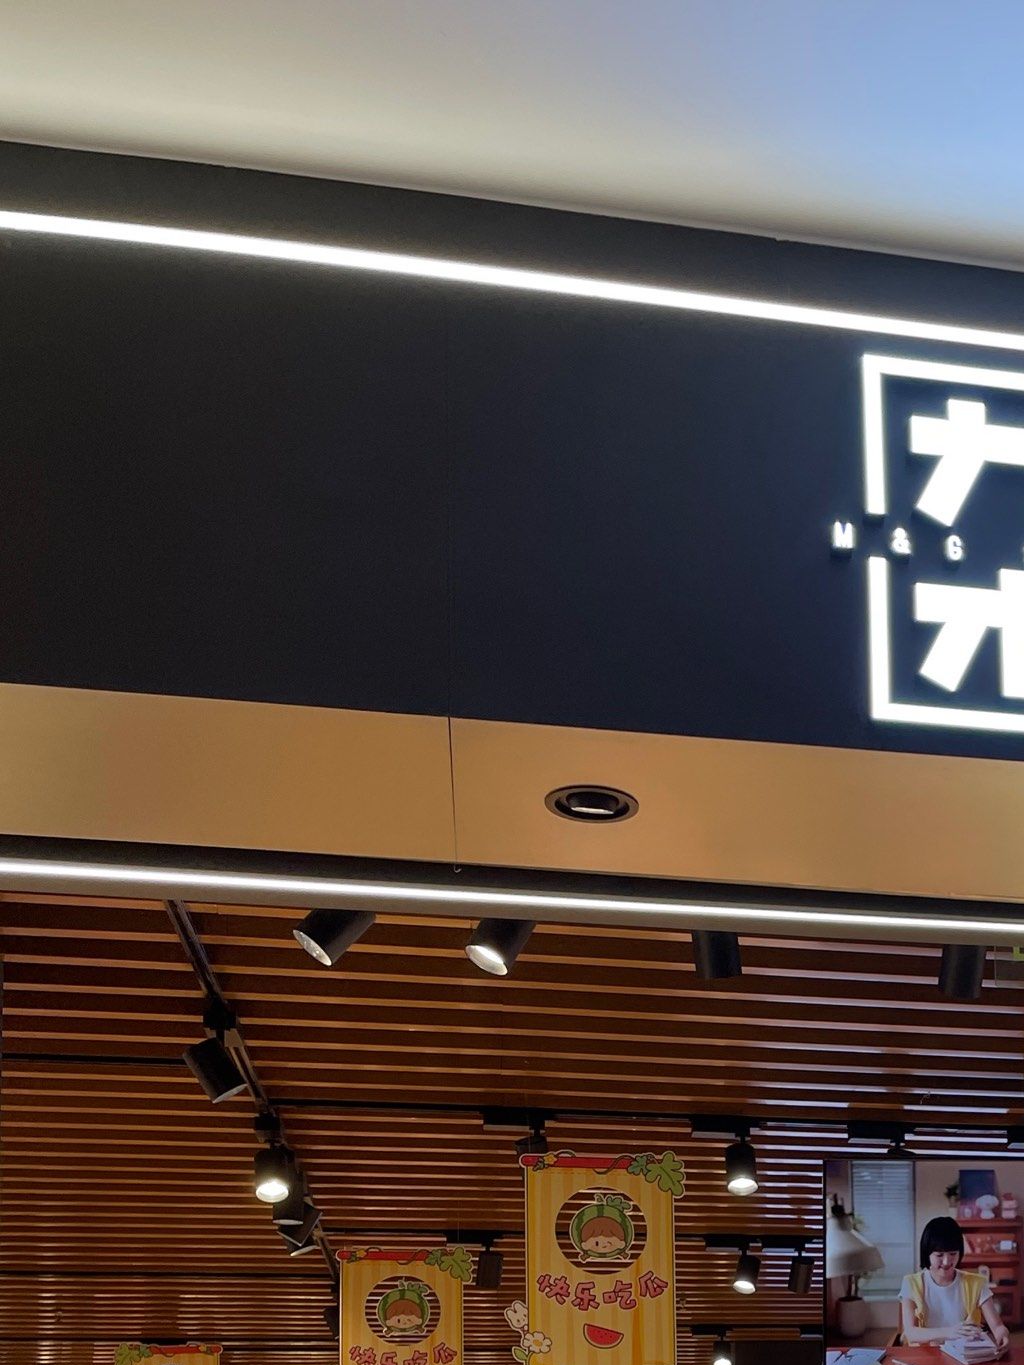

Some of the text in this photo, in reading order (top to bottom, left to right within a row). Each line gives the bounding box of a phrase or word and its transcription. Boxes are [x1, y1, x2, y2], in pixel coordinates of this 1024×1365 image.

[832, 520, 965, 563] M&G
[536, 1270, 669, 1311] 快乐吃瓜
